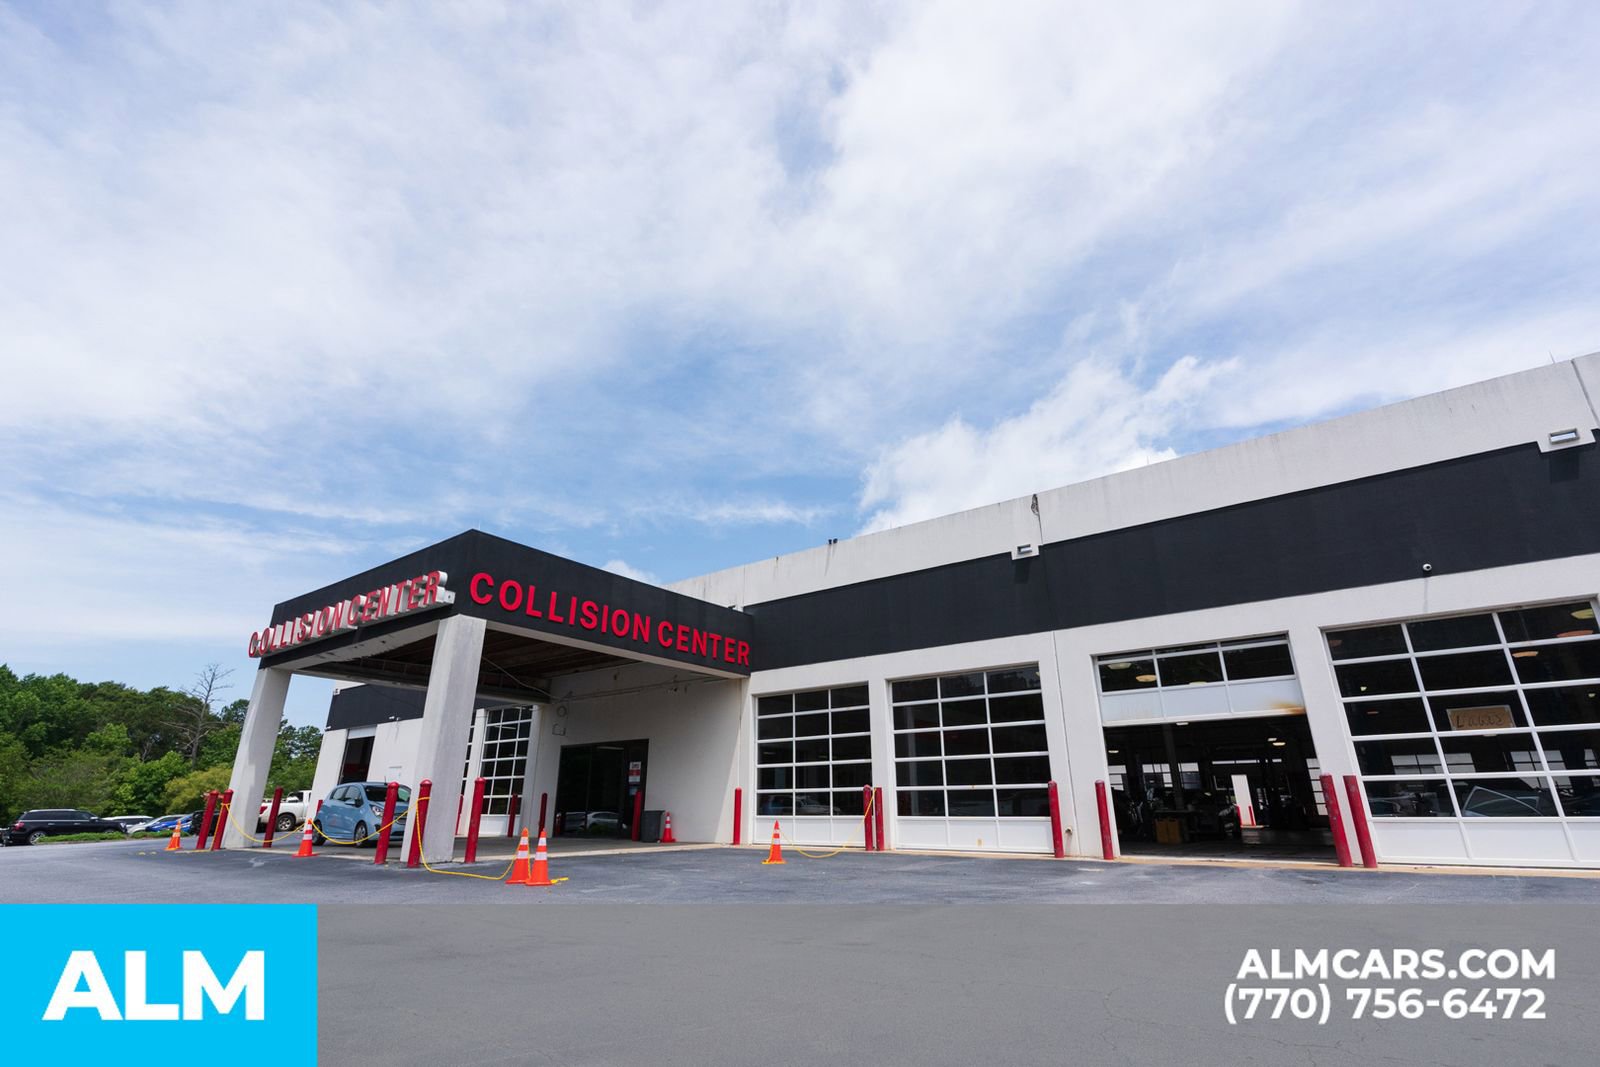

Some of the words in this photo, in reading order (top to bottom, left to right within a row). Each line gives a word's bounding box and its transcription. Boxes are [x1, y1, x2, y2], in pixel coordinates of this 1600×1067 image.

[248, 600, 350, 658] COLLISION
[347, 570, 447, 626] CENTER
[469, 572, 651, 644] COLLISION
[657, 620, 752, 667] CENTER
